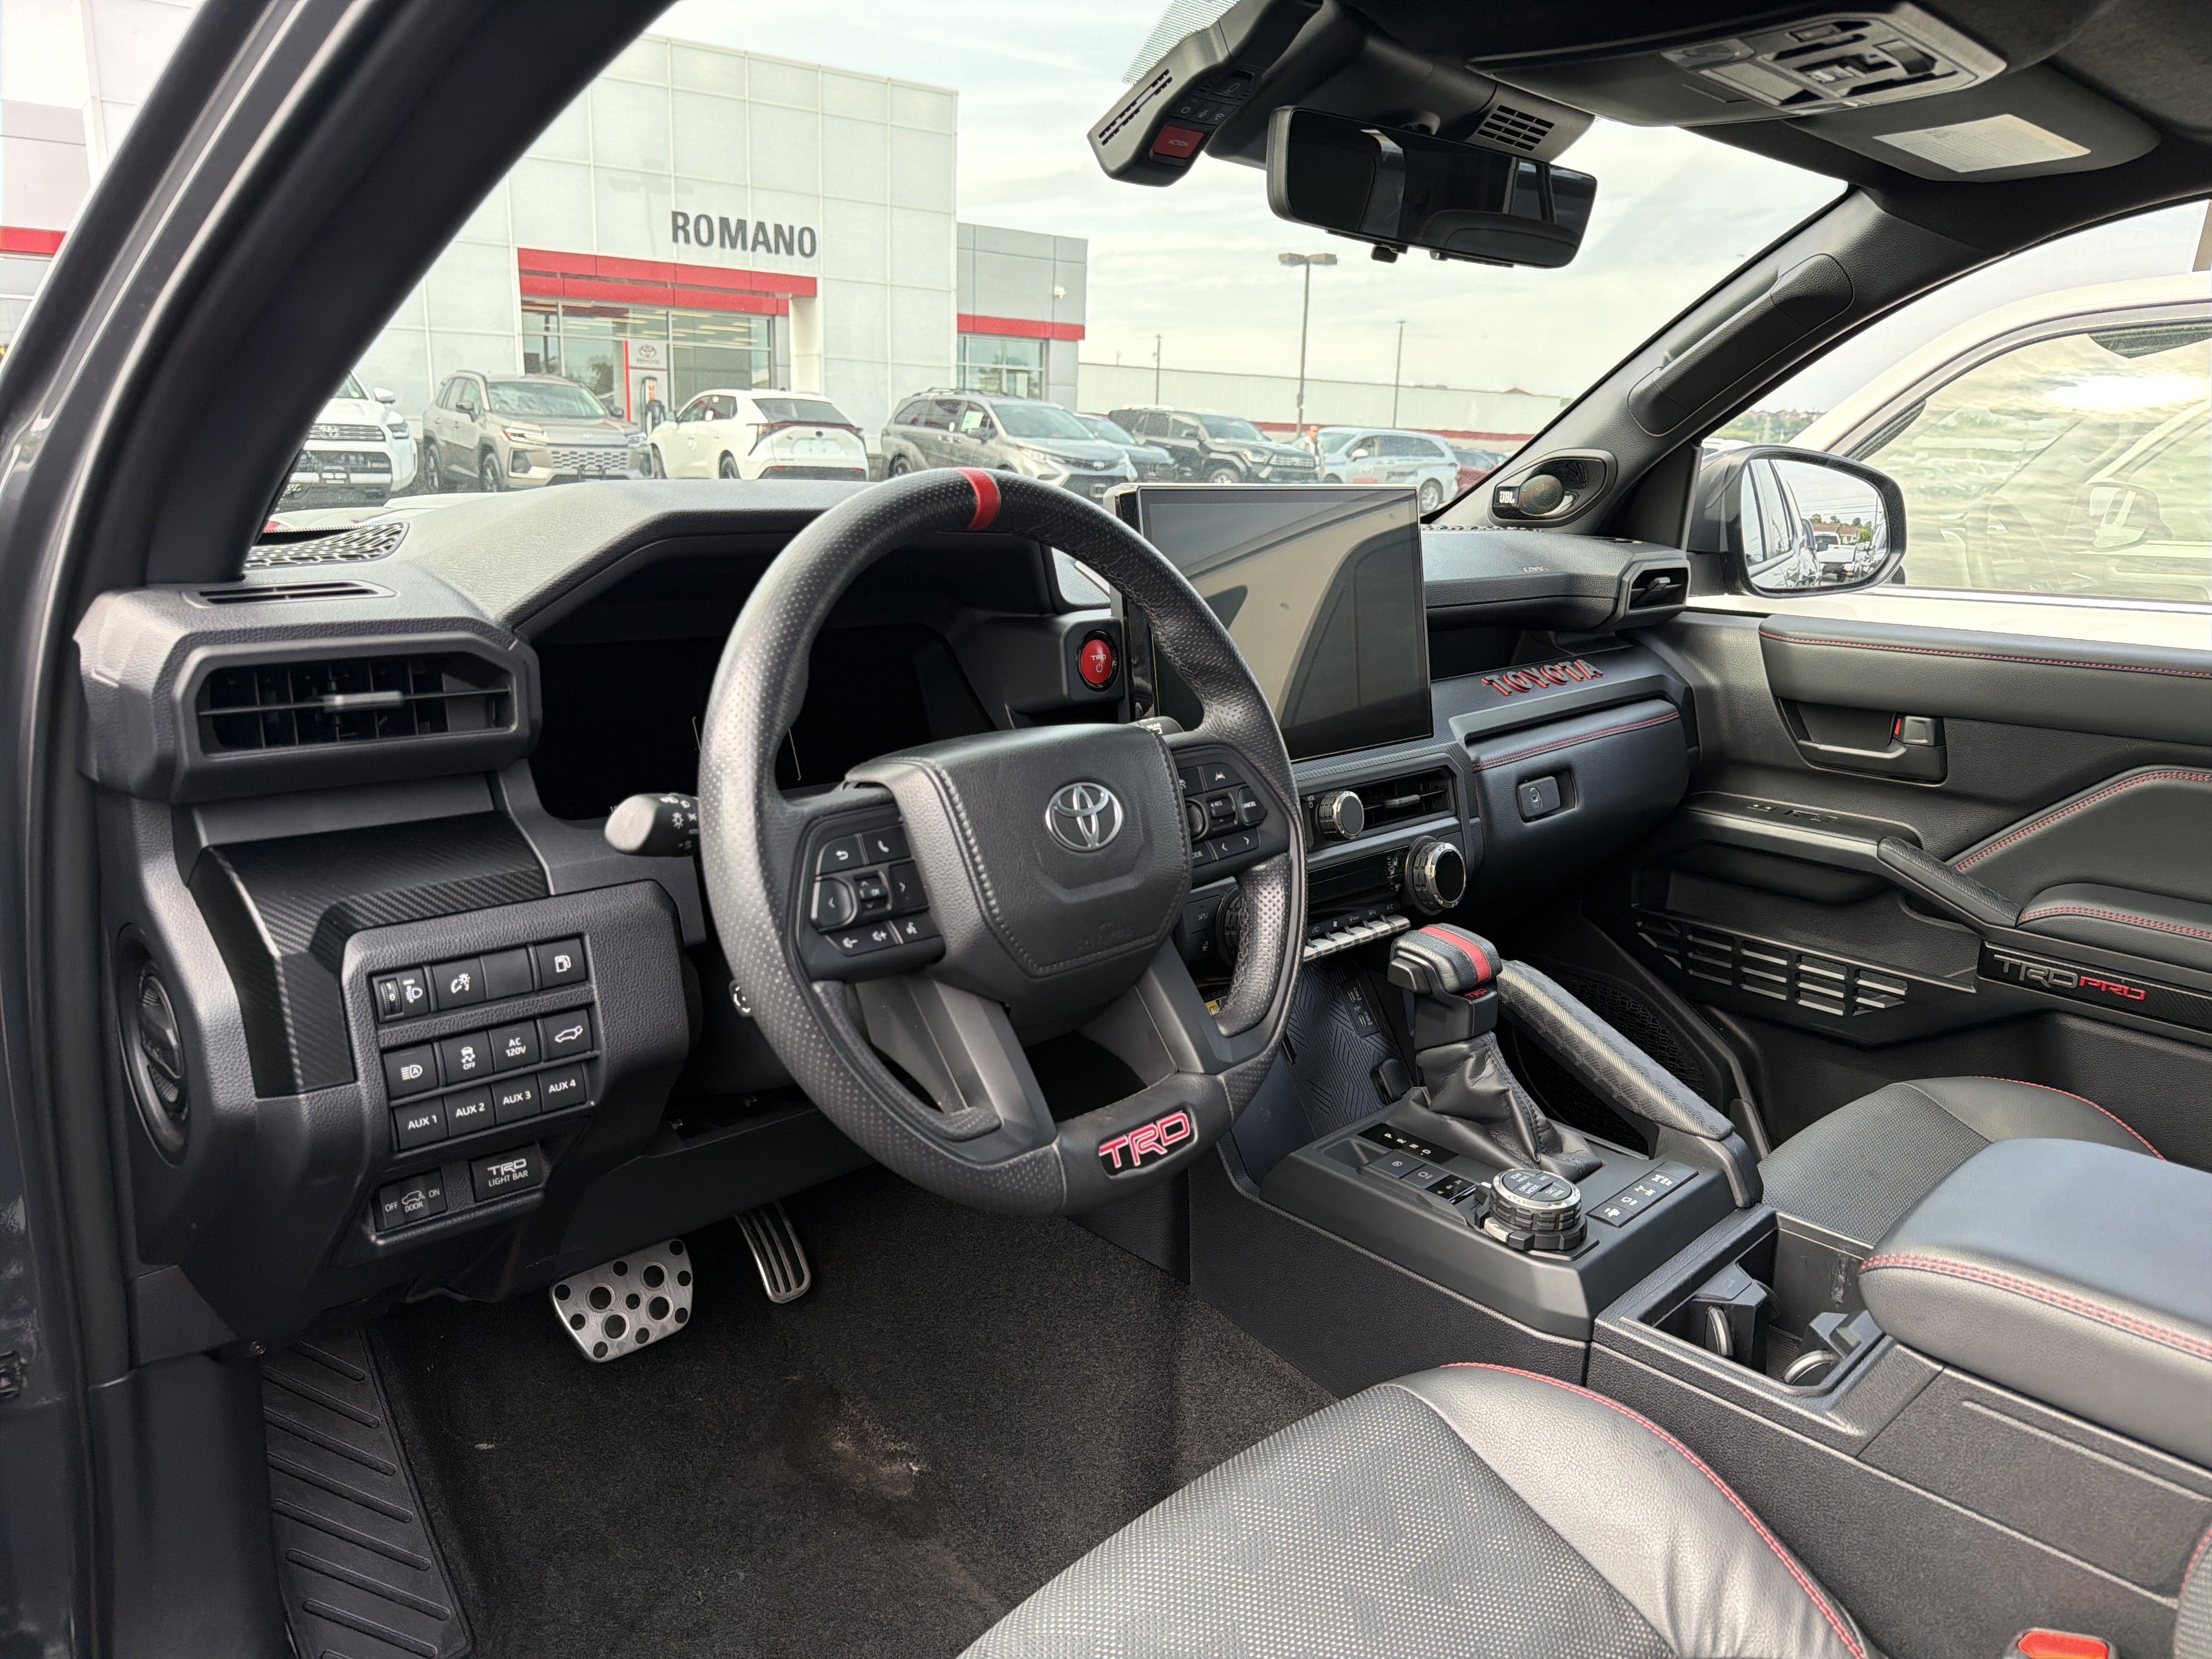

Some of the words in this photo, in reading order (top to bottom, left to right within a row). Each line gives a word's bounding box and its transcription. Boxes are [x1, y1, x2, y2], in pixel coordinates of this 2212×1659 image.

[670, 210, 817, 258] ROMANO
[1499, 490, 1515, 504] JBL
[1481, 658, 1604, 696] TOYOTA
[1241, 801, 1257, 809] CANCEL
[1192, 850, 1203, 859] ODE
[1994, 954, 2079, 989] TRD
[2079, 975, 2147, 1001] PRO
[508, 1036, 522, 1047] AC
[505, 1044, 527, 1058] 120V
[462, 1061, 476, 1071] OFF
[548, 1080, 568, 1094] AUX
[568, 1078, 577, 1089] 4
[503, 1093, 523, 1106] AUX
[524, 1091, 532, 1101] 3
[455, 1104, 478, 1119] AUX
[478, 1102, 486, 1113] 2
[408, 1117, 429, 1130] AUX
[431, 1114, 438, 1124] 1
[1098, 1109, 1191, 1169] TRD
[487, 1158, 528, 1176] TRD
[488, 1174, 511, 1188] LIGHT
[512, 1169, 529, 1181] BAR
[428, 1187, 441, 1199] ON
[1519, 1181, 1534, 1192] DRIVE
[1525, 1184, 1541, 1195] MODE
[385, 1200, 399, 1212] OFF
[404, 1200, 424, 1213] DOOR
